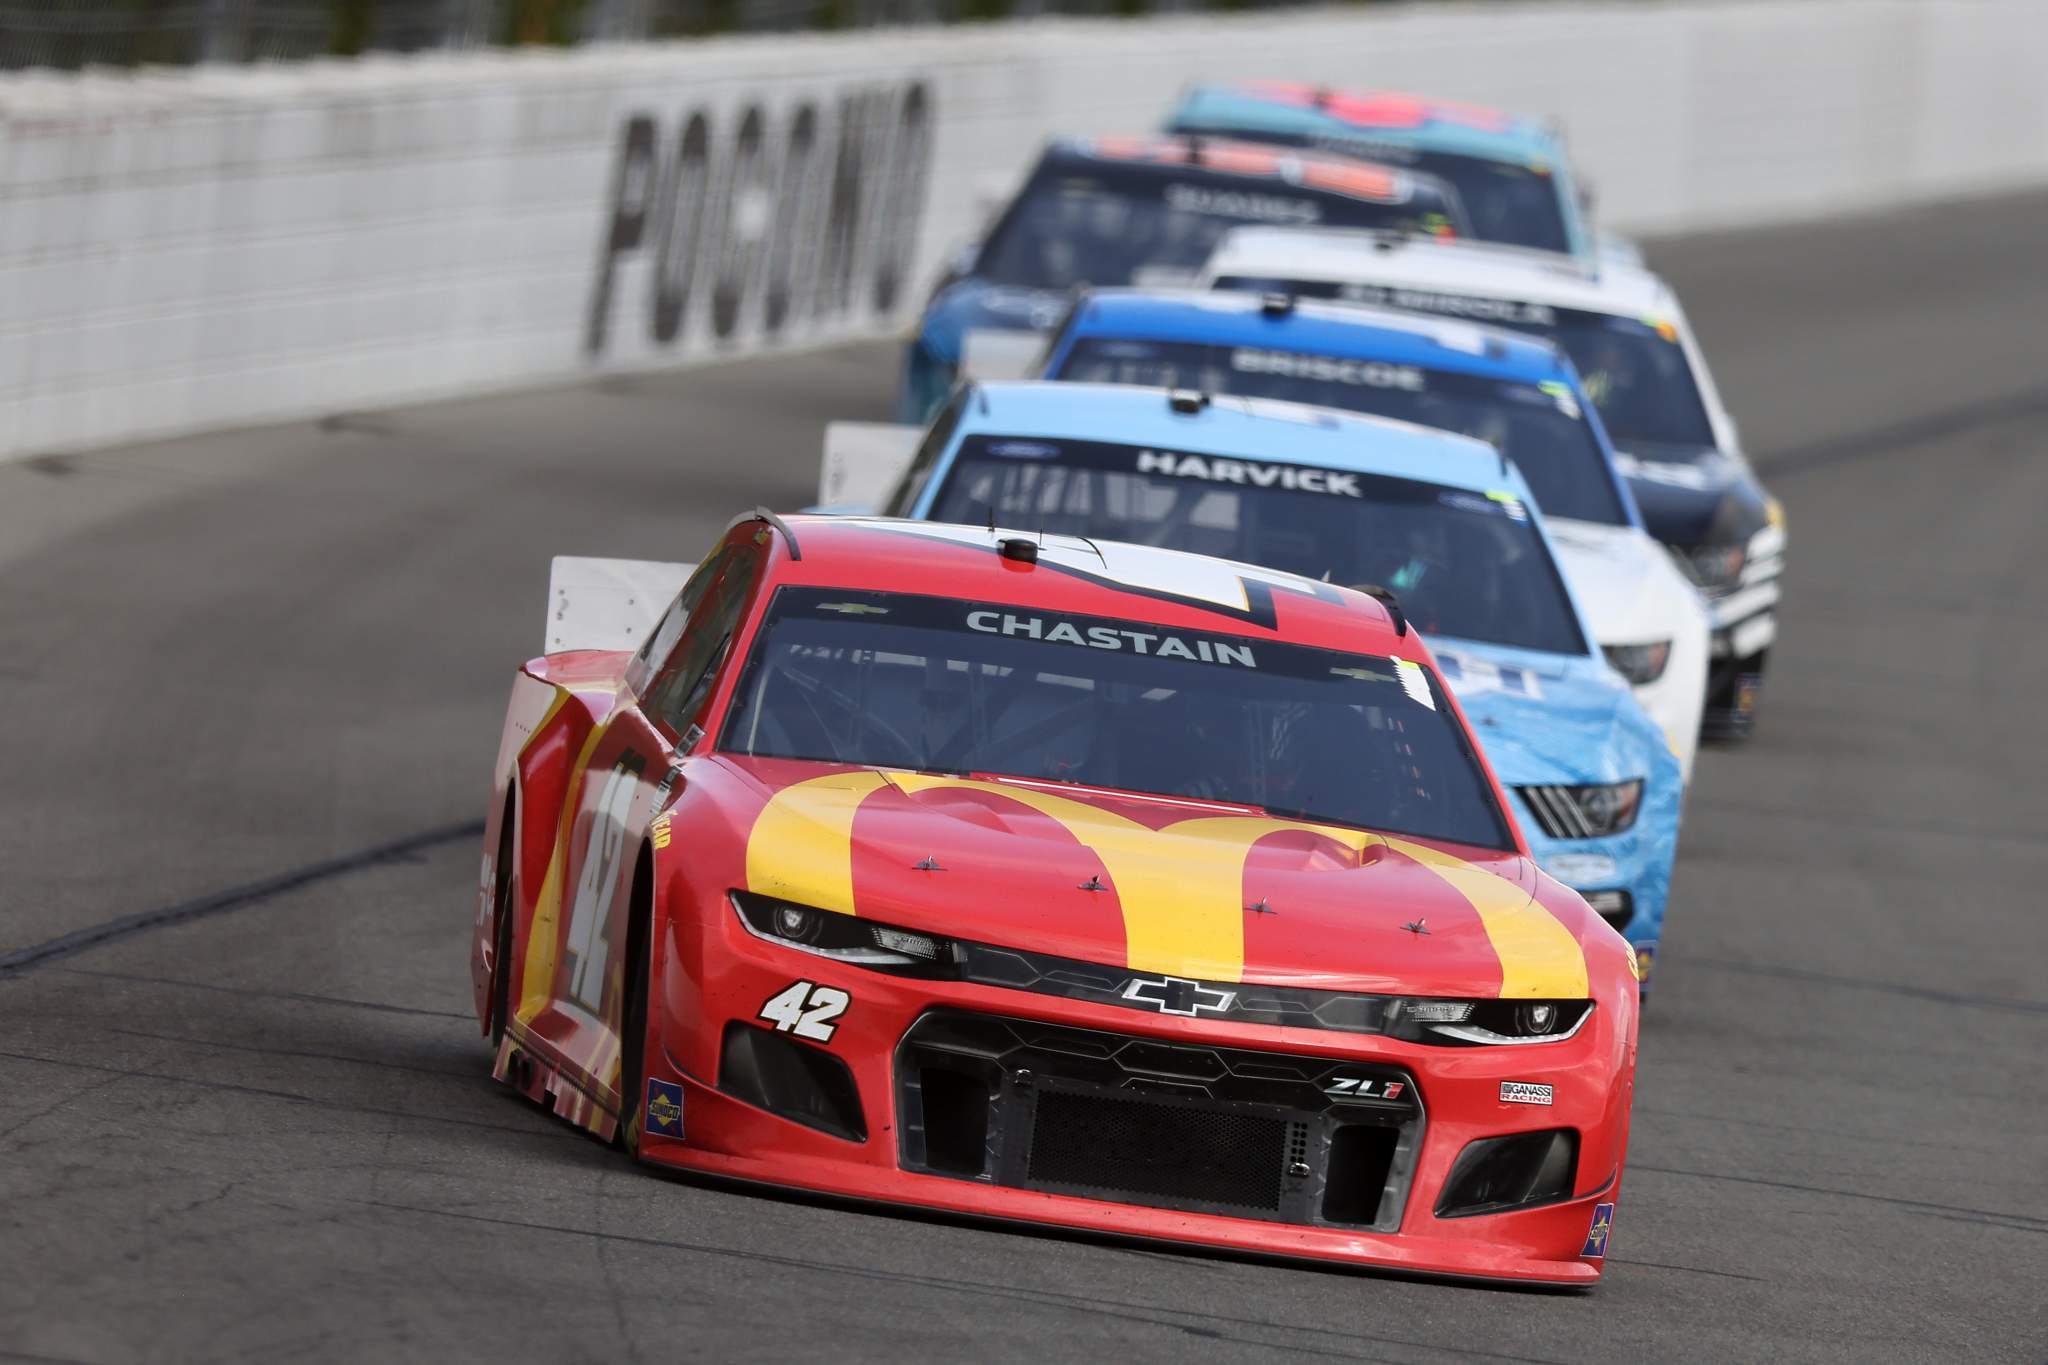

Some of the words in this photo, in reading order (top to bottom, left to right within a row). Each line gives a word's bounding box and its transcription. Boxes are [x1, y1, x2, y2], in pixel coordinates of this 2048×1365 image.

[1232, 349, 1425, 390] BRISCOE
[1136, 450, 1363, 498] HARVICK
[966, 611, 1257, 668] CHASTAIN
[757, 979, 851, 1044] 42
[1323, 1077, 1405, 1100] ZL1
[1501, 1093, 1552, 1104] RACING
[1511, 1084, 1551, 1097] GANASSI
